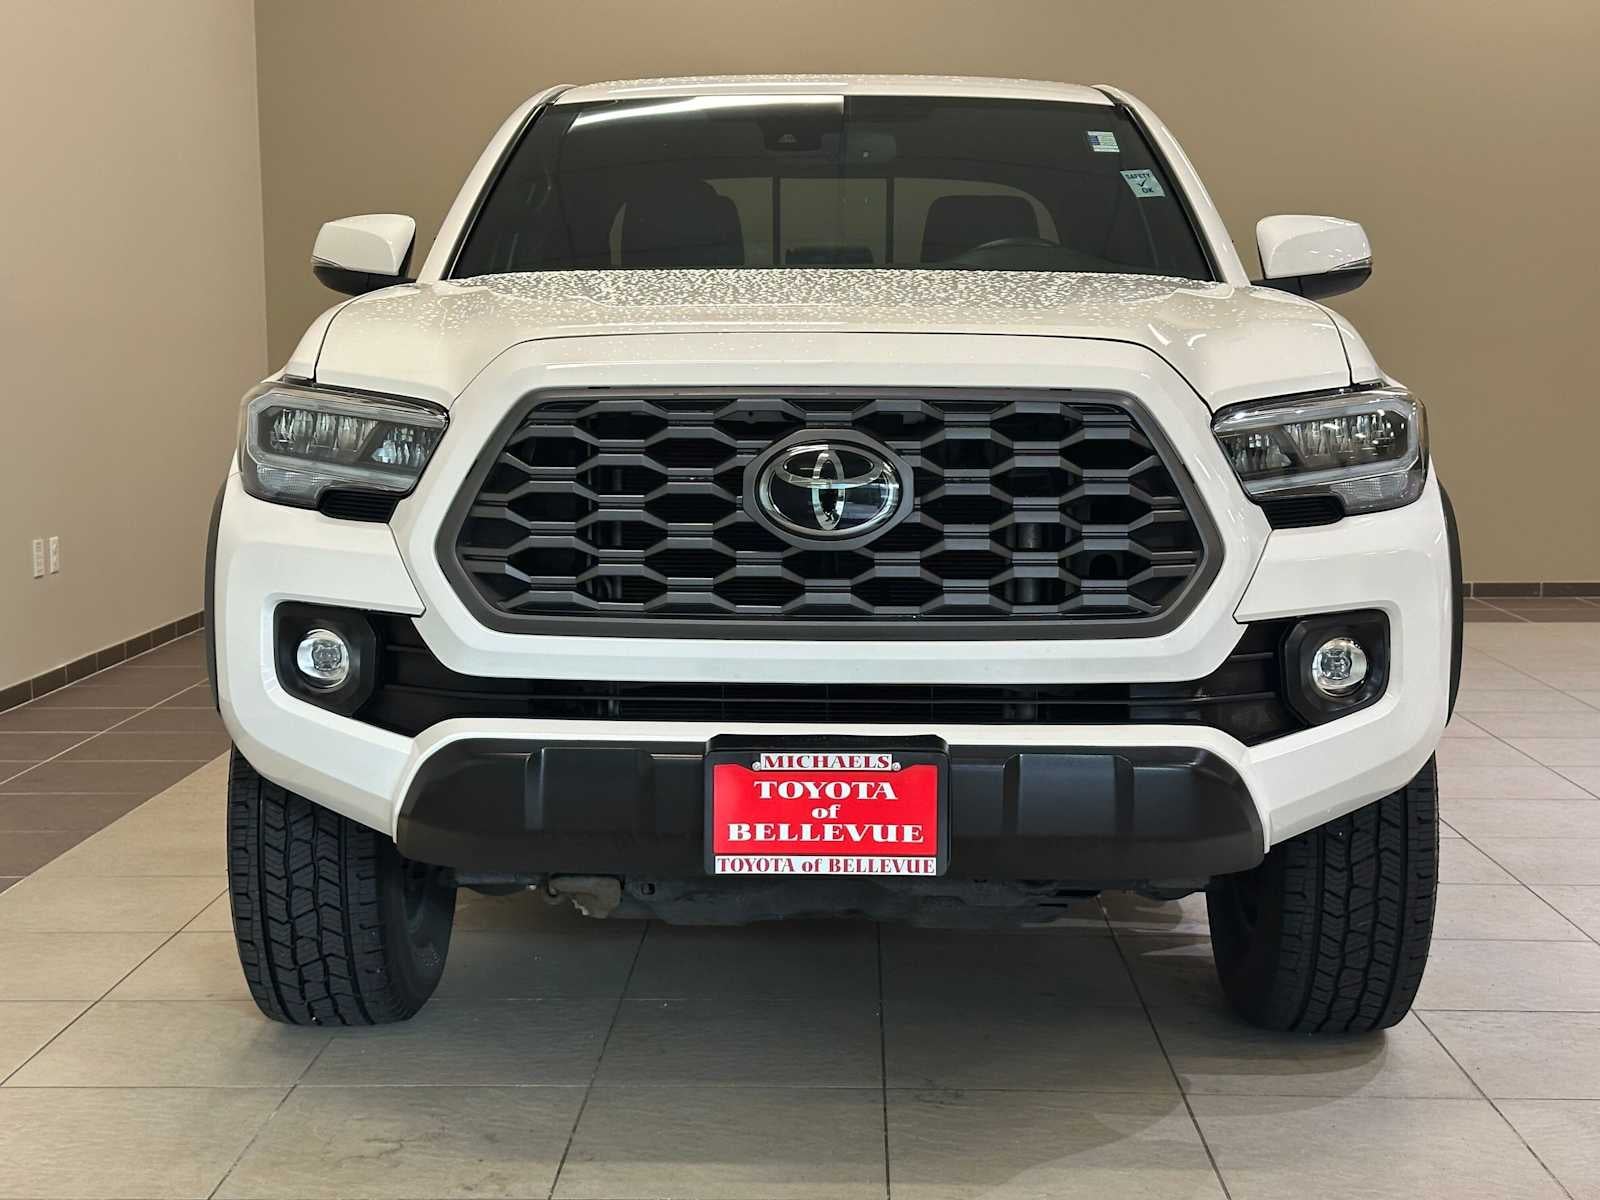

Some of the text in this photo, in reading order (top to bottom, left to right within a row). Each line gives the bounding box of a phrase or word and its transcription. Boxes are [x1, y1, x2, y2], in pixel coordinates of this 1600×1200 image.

[764, 755, 890, 769] MICHAELS
[754, 781, 898, 800] TOYOTA
[811, 804, 841, 819] of
[727, 823, 924, 843] BELLEVUE
[717, 857, 935, 874] TOYOTA of BELLEVUE
